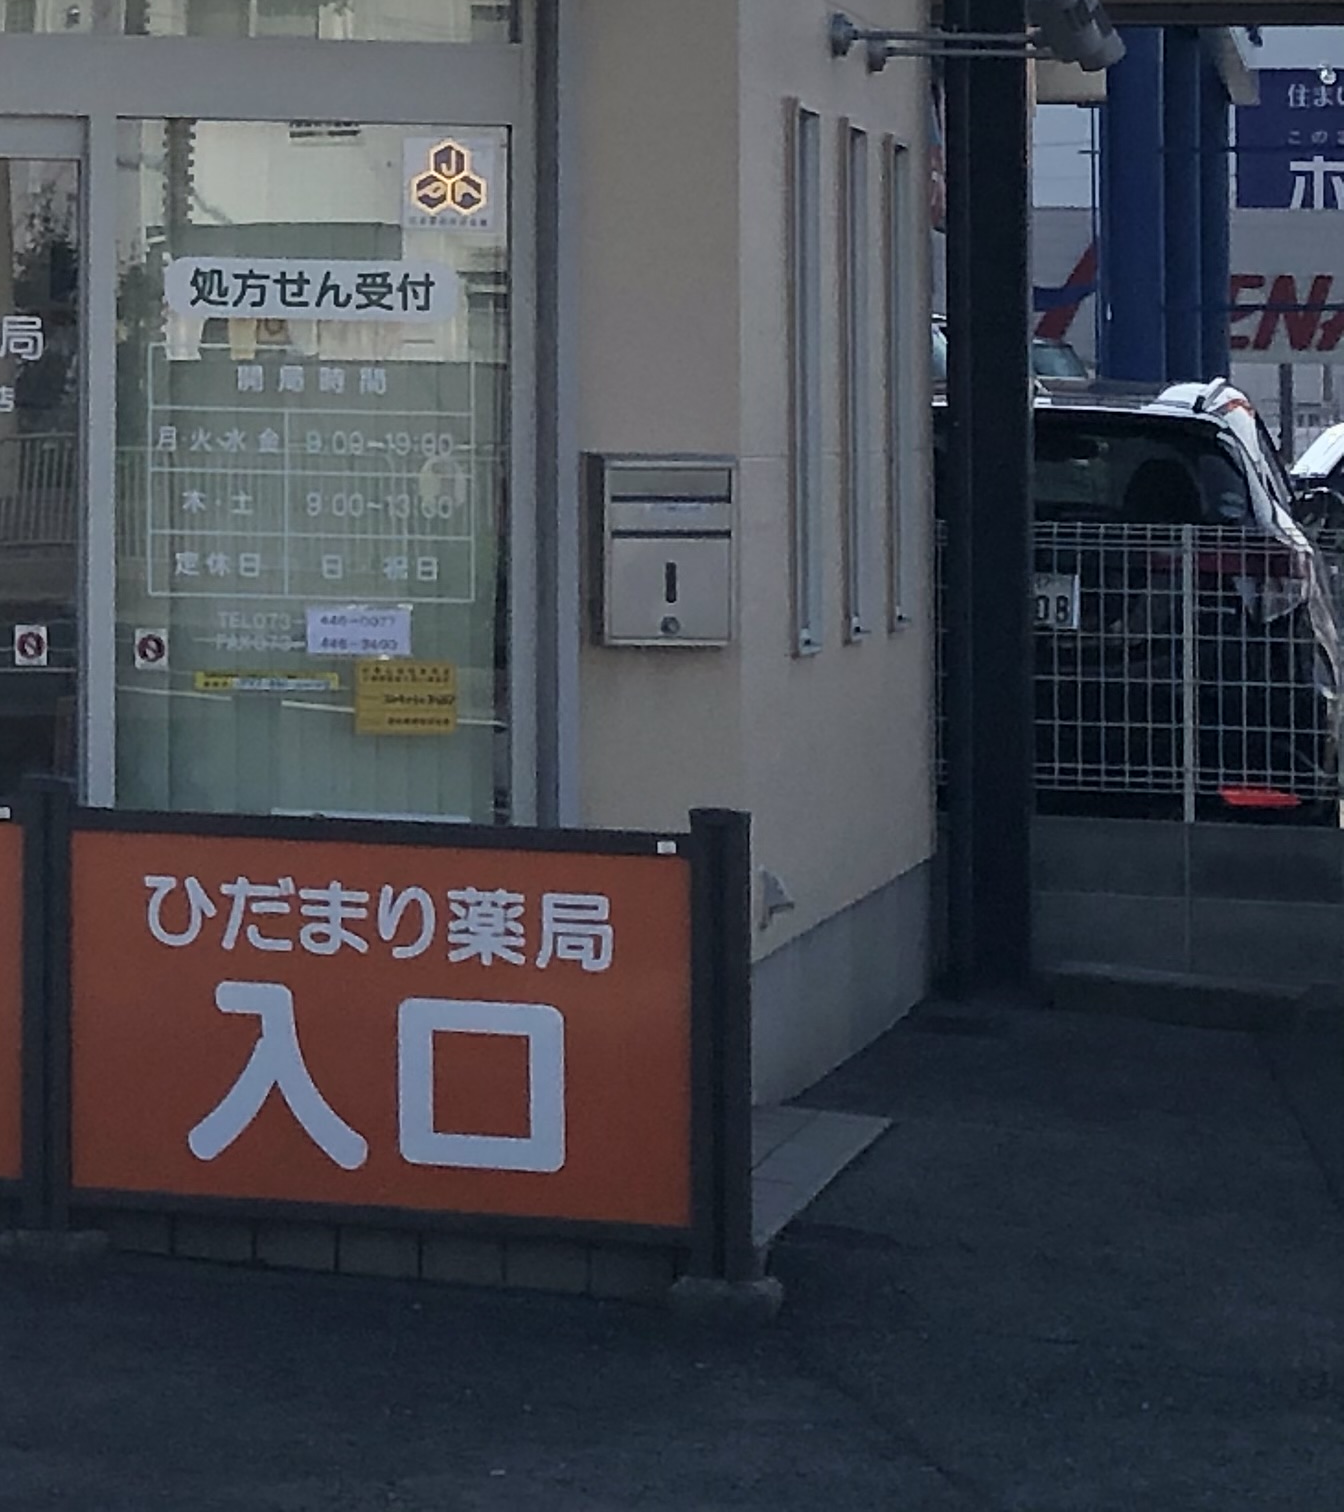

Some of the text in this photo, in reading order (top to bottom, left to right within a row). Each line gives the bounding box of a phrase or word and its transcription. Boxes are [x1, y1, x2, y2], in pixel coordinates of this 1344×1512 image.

[189, 267, 436, 312] 処方せん受付
[173, 551, 261, 578] 定休日
[142, 871, 617, 974] ひだまり薬局
[186, 979, 568, 1175] 入口
